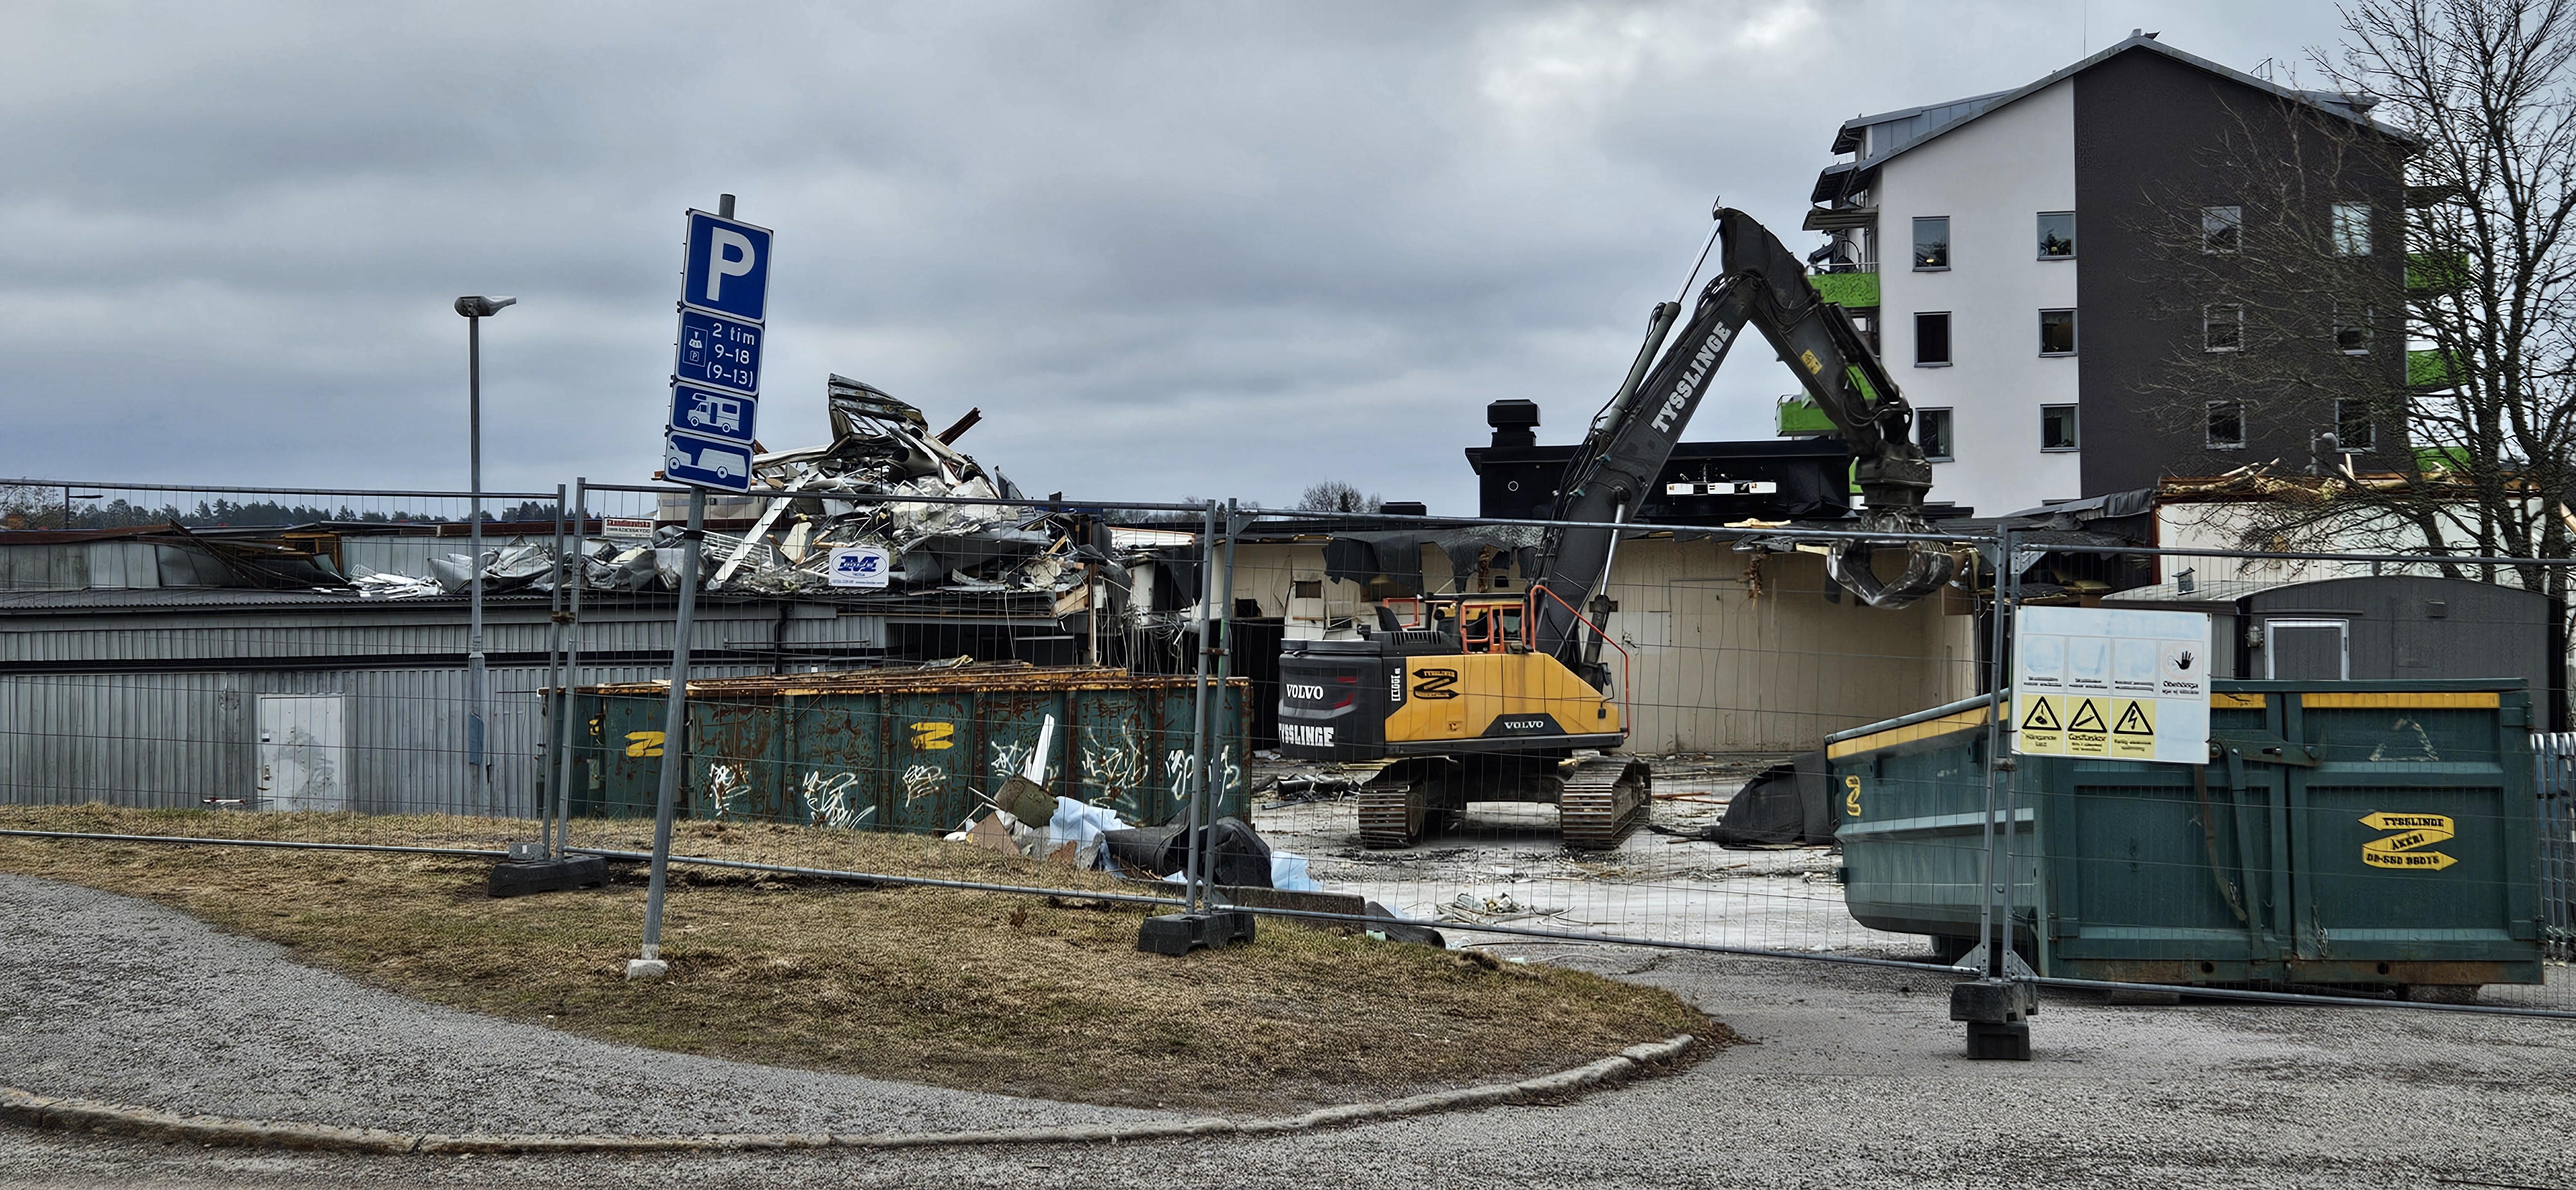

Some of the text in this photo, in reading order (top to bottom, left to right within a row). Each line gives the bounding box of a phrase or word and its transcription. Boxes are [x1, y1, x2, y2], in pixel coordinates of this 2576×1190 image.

[706, 227, 755, 301] P
[712, 323, 754, 345] 2 tim
[715, 344, 749, 364] 9-18
[707, 362, 753, 388] (9-13)
[1651, 321, 1732, 433] TYSSLINGE
[1286, 684, 1323, 699] VOLVO
[1504, 721, 1544, 729] VOLVO
